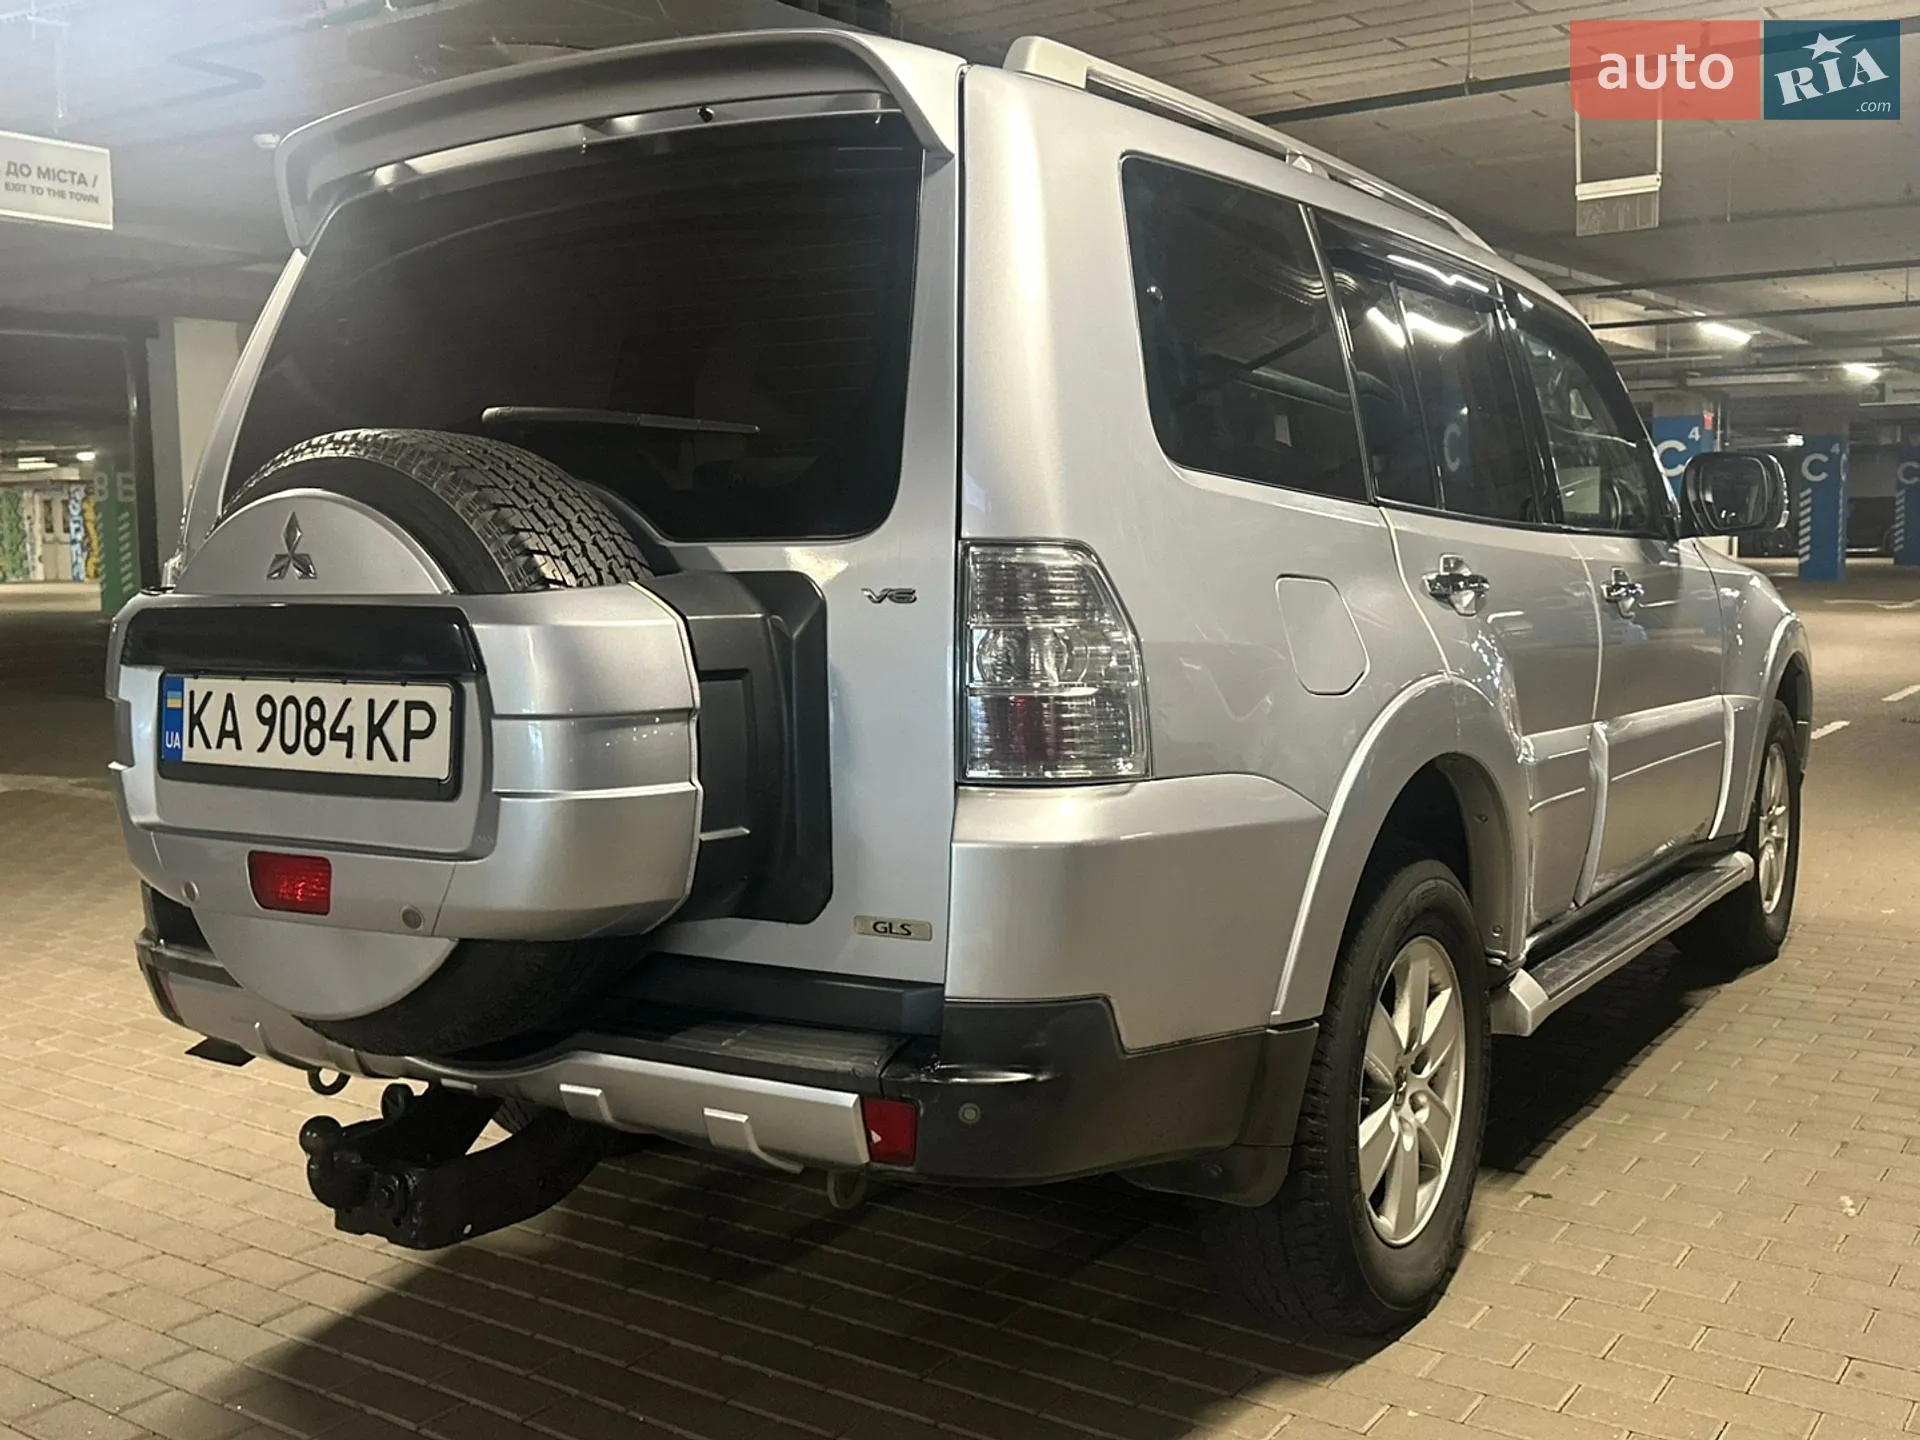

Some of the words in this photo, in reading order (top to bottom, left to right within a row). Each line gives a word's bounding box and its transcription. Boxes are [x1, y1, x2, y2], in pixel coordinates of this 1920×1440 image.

[5, 160, 32, 178] ДО
[37, 165, 88, 187] МІСТА
[4, 181, 27, 193] EXIT
[30, 185, 44, 196] TO
[46, 187, 67, 200] THE
[67, 191, 99, 204] TOWN
[861, 587, 917, 604] V6
[188, 690, 242, 751] KA
[256, 694, 354, 759] 9084
[366, 698, 437, 762] KP
[165, 731, 181, 750] UA
[872, 920, 912, 936] GLS
